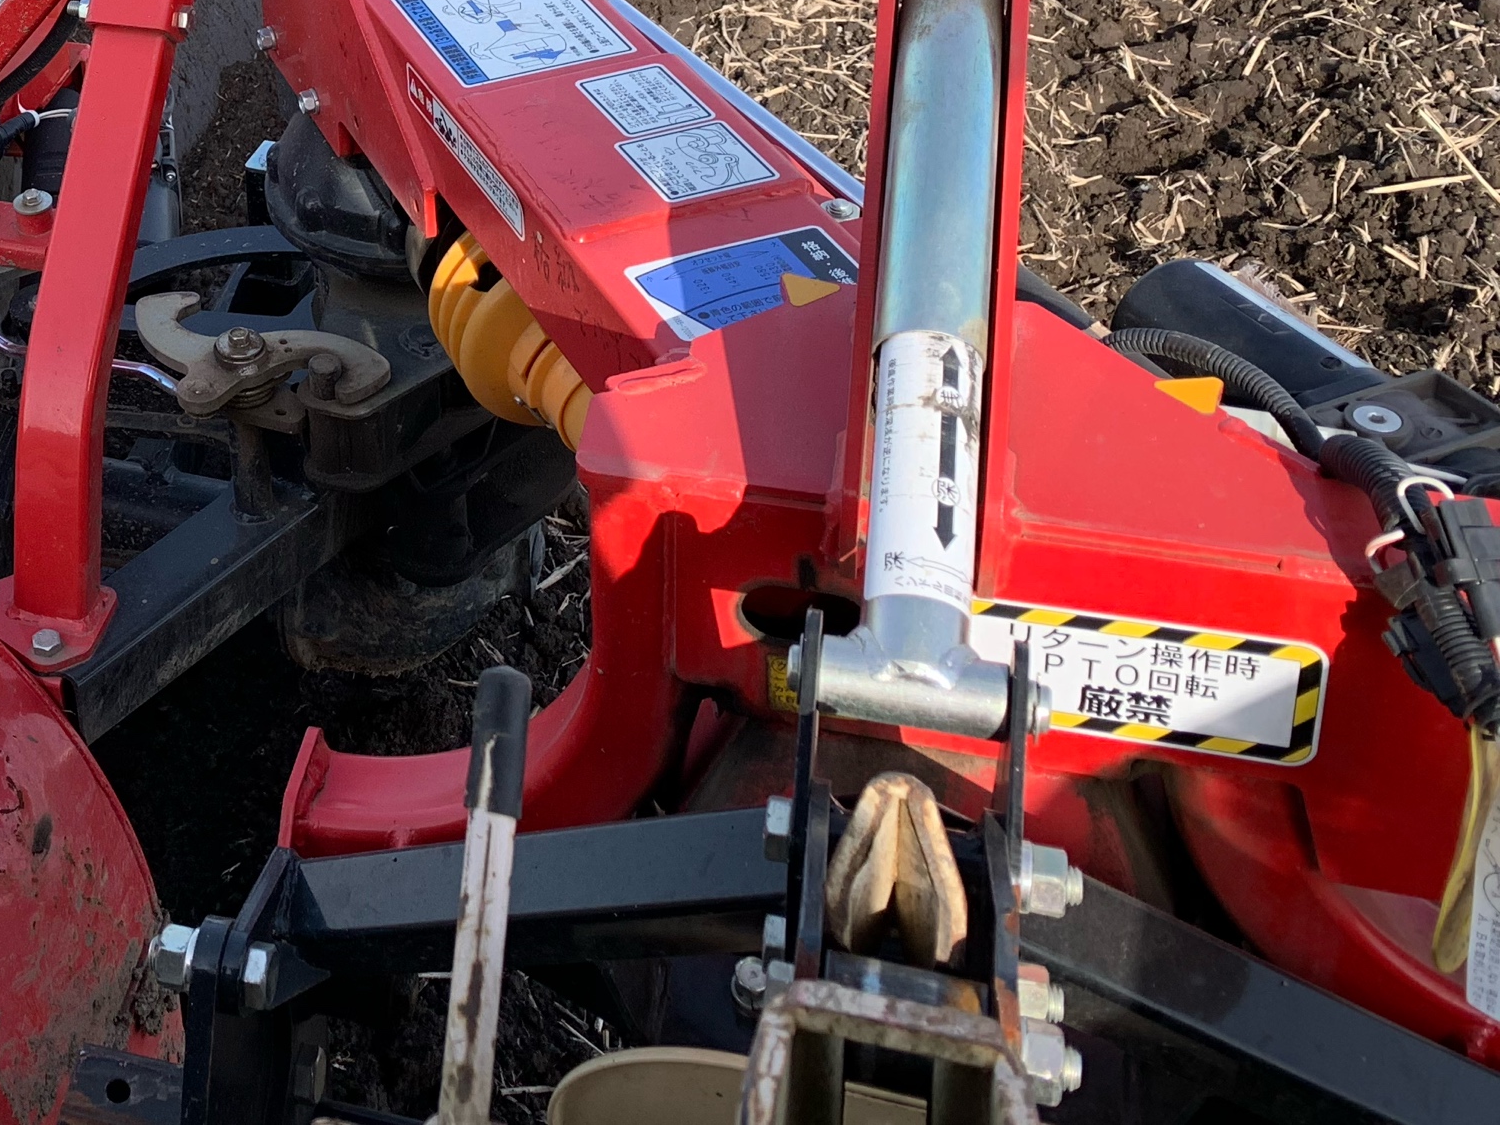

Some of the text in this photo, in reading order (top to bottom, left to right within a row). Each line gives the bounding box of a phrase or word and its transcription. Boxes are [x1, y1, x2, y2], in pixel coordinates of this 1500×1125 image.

[691, 278, 714, 294] 1320
[1010, 623, 1261, 681] リターン操作時
[1078, 684, 1173, 726] 厳禁
